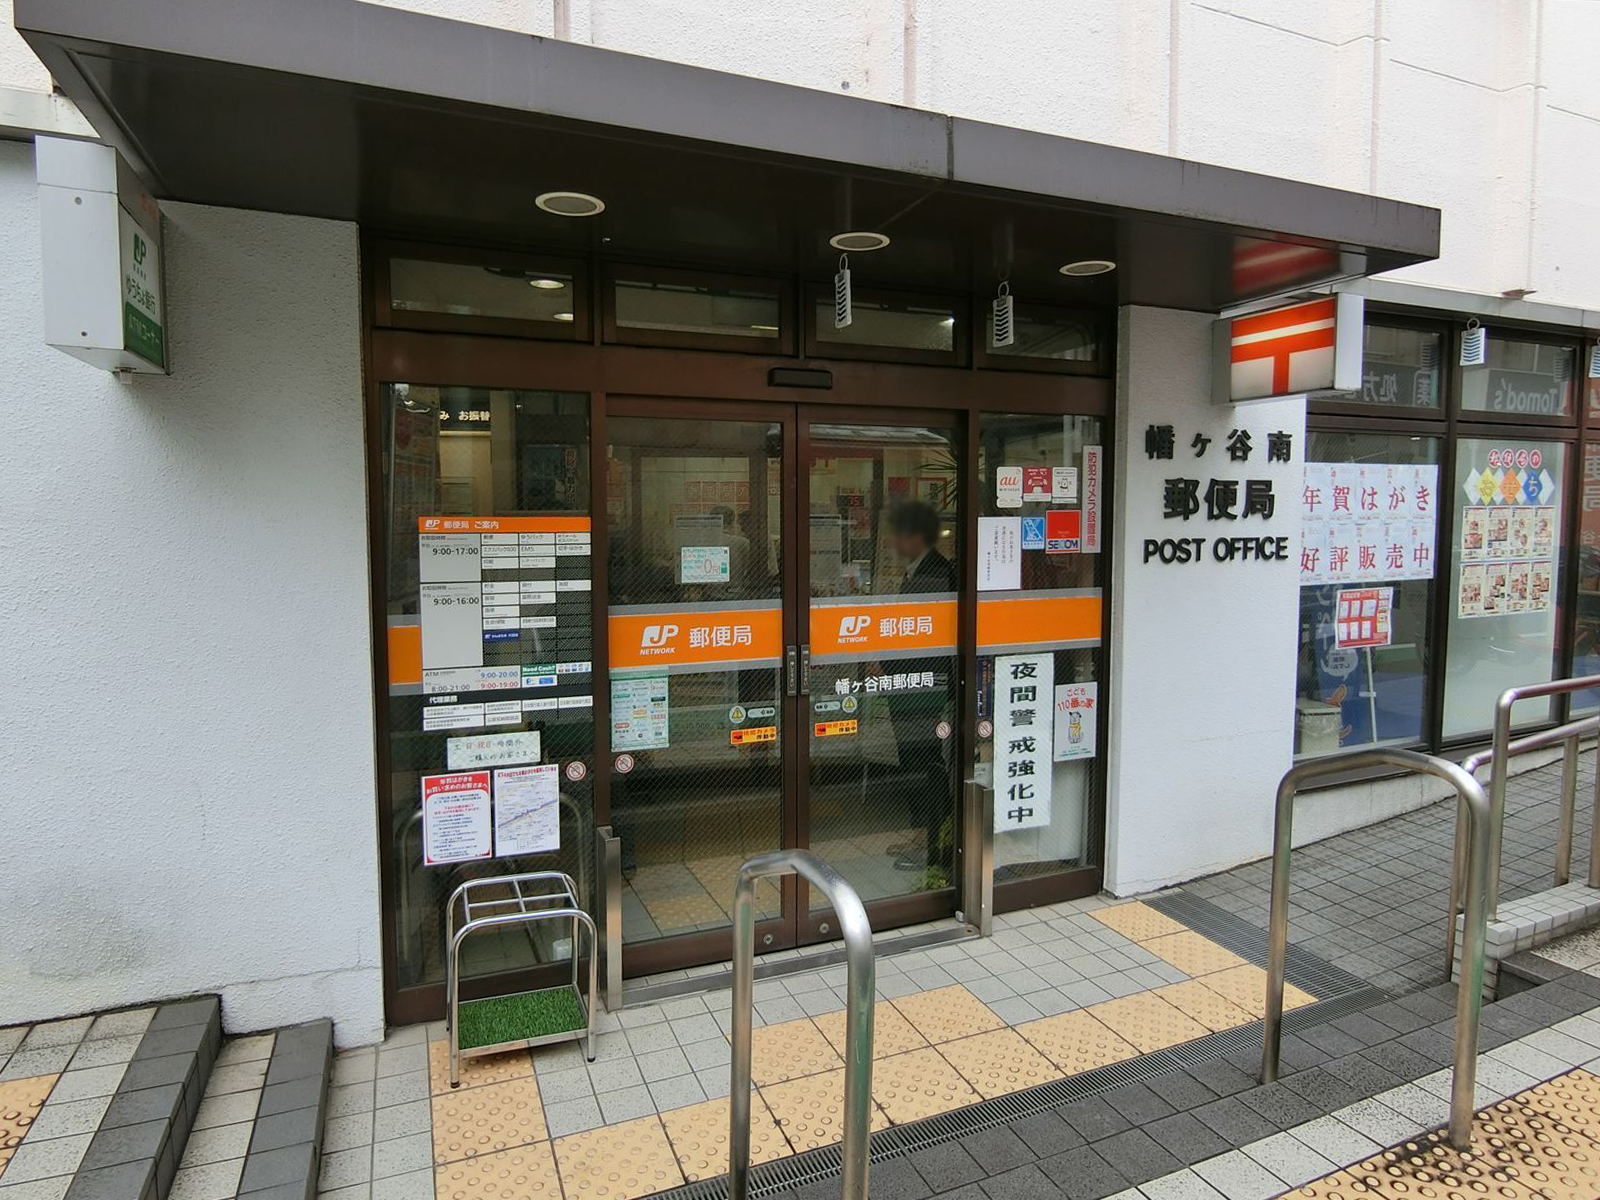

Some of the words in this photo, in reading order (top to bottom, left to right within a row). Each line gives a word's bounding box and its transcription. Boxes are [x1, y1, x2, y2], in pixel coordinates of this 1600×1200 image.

[1000, 475, 1018, 486] au
[1164, 478, 1275, 521] 郵便局
[1303, 485, 1430, 513] 年賀はがき
[474, 520, 499, 529] ご案内
[432, 547, 479, 556] 9:00-17:00
[1048, 539, 1079, 549] SECOM
[1143, 538, 1206, 564] POST
[1213, 536, 1289, 561] OFFICE
[1300, 542, 1430, 573] 好評販売中
[433, 597, 479, 605] 9:00-16:00
[839, 615, 871, 636] JP
[879, 615, 933, 637] 郵便局
[642, 624, 679, 647] JP
[689, 625, 752, 648] 郵便局
[837, 636, 868, 645] NETWORK
[639, 647, 676, 655] NETWORK
[480, 681, 518, 689] 9:00-19:00
[1066, 686, 1086, 696] こども
[1057, 697, 1095, 712] 110番の家
[1007, 662, 1038, 823] 夜間警戒強化中
